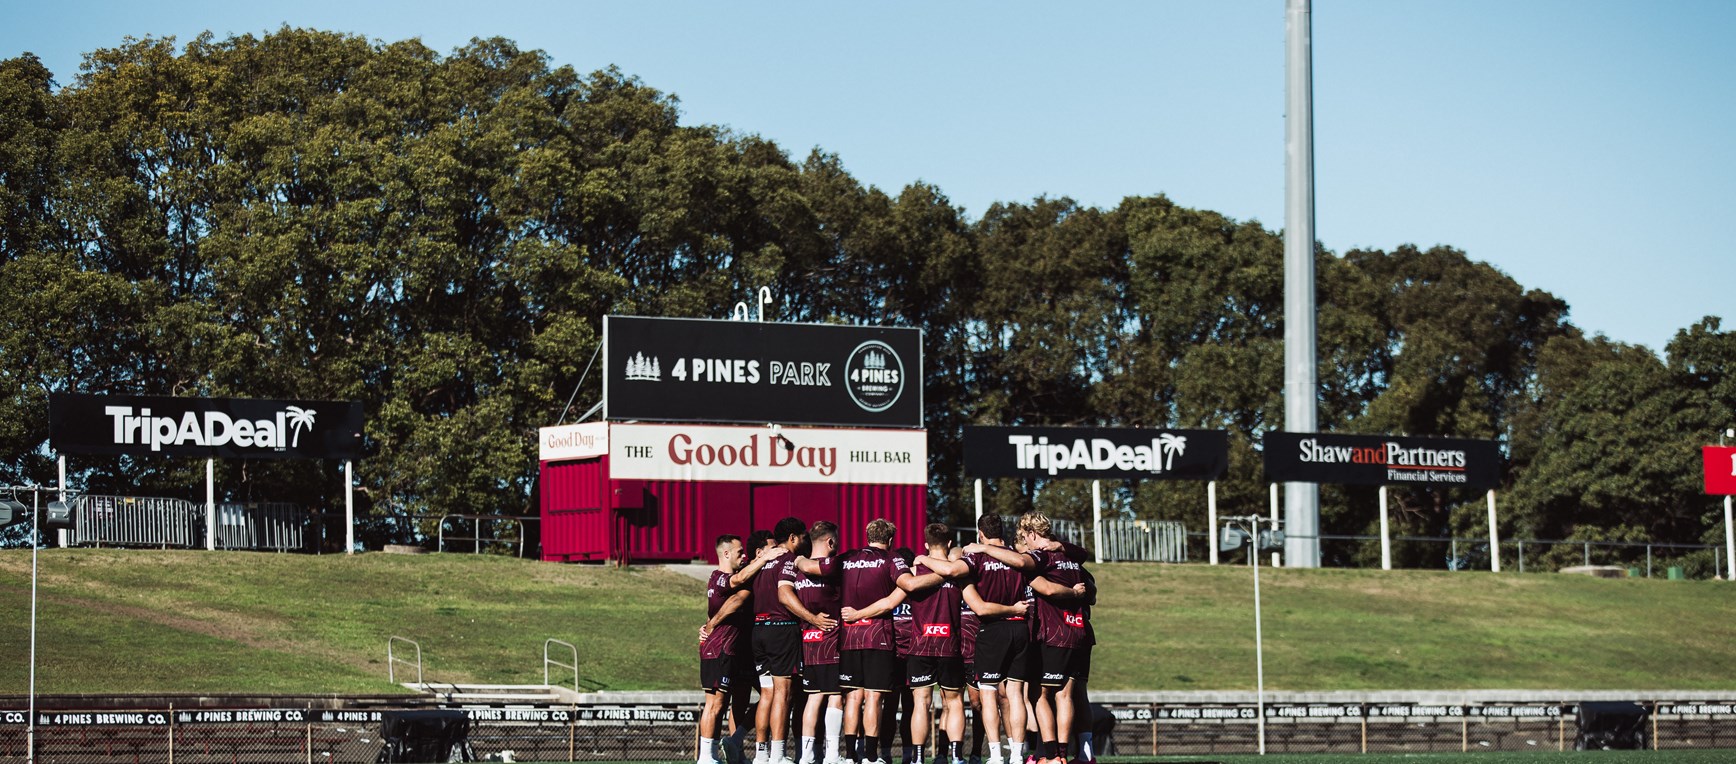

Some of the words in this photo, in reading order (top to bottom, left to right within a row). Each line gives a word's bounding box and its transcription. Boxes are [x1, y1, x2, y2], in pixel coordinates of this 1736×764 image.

[671, 358, 687, 381] 4
[692, 358, 760, 384] PINES
[769, 361, 831, 386] PARK
[850, 368, 860, 382] 4
[861, 369, 899, 384] PINES
[105, 405, 286, 451] TripADeal
[548, 431, 573, 448] Good
[575, 431, 594, 449] Day
[624, 445, 653, 458] THE
[668, 433, 759, 466] Good
[768, 435, 837, 476] Day
[850, 450, 881, 463] HILL
[884, 451, 911, 464] BAR
[1008, 434, 1162, 475] TripADeal
[1387, 469, 1428, 482] Financial
[1429, 470, 1466, 483] Services
[925, 626, 948, 634] KFC
[911, 674, 931, 683] Zantac
[6, 712, 25, 723] CO.
[195, 712, 202, 721] 4
[203, 711, 232, 721] PINES
[236, 710, 281, 721] BREWING
[285, 711, 304, 721] CO.
[337, 712, 343, 721] 4
[344, 711, 368, 721] PINES
[468, 711, 474, 719] 4
[475, 710, 502, 720] PINES
[505, 710, 548, 720] BREWING
[552, 711, 569, 720] CO.
[596, 710, 603, 719] 4
[604, 710, 631, 720] PINES
[634, 710, 675, 720] BREWING
[678, 711, 694, 720] CO.
[1171, 708, 1177, 718] 4
[1177, 708, 1200, 718] PINES
[1202, 708, 1239, 718] BREWING
[55, 714, 61, 724] 4
[63, 714, 92, 724] PINES
[96, 714, 144, 724] BREWING
[147, 714, 166, 724] CO.
